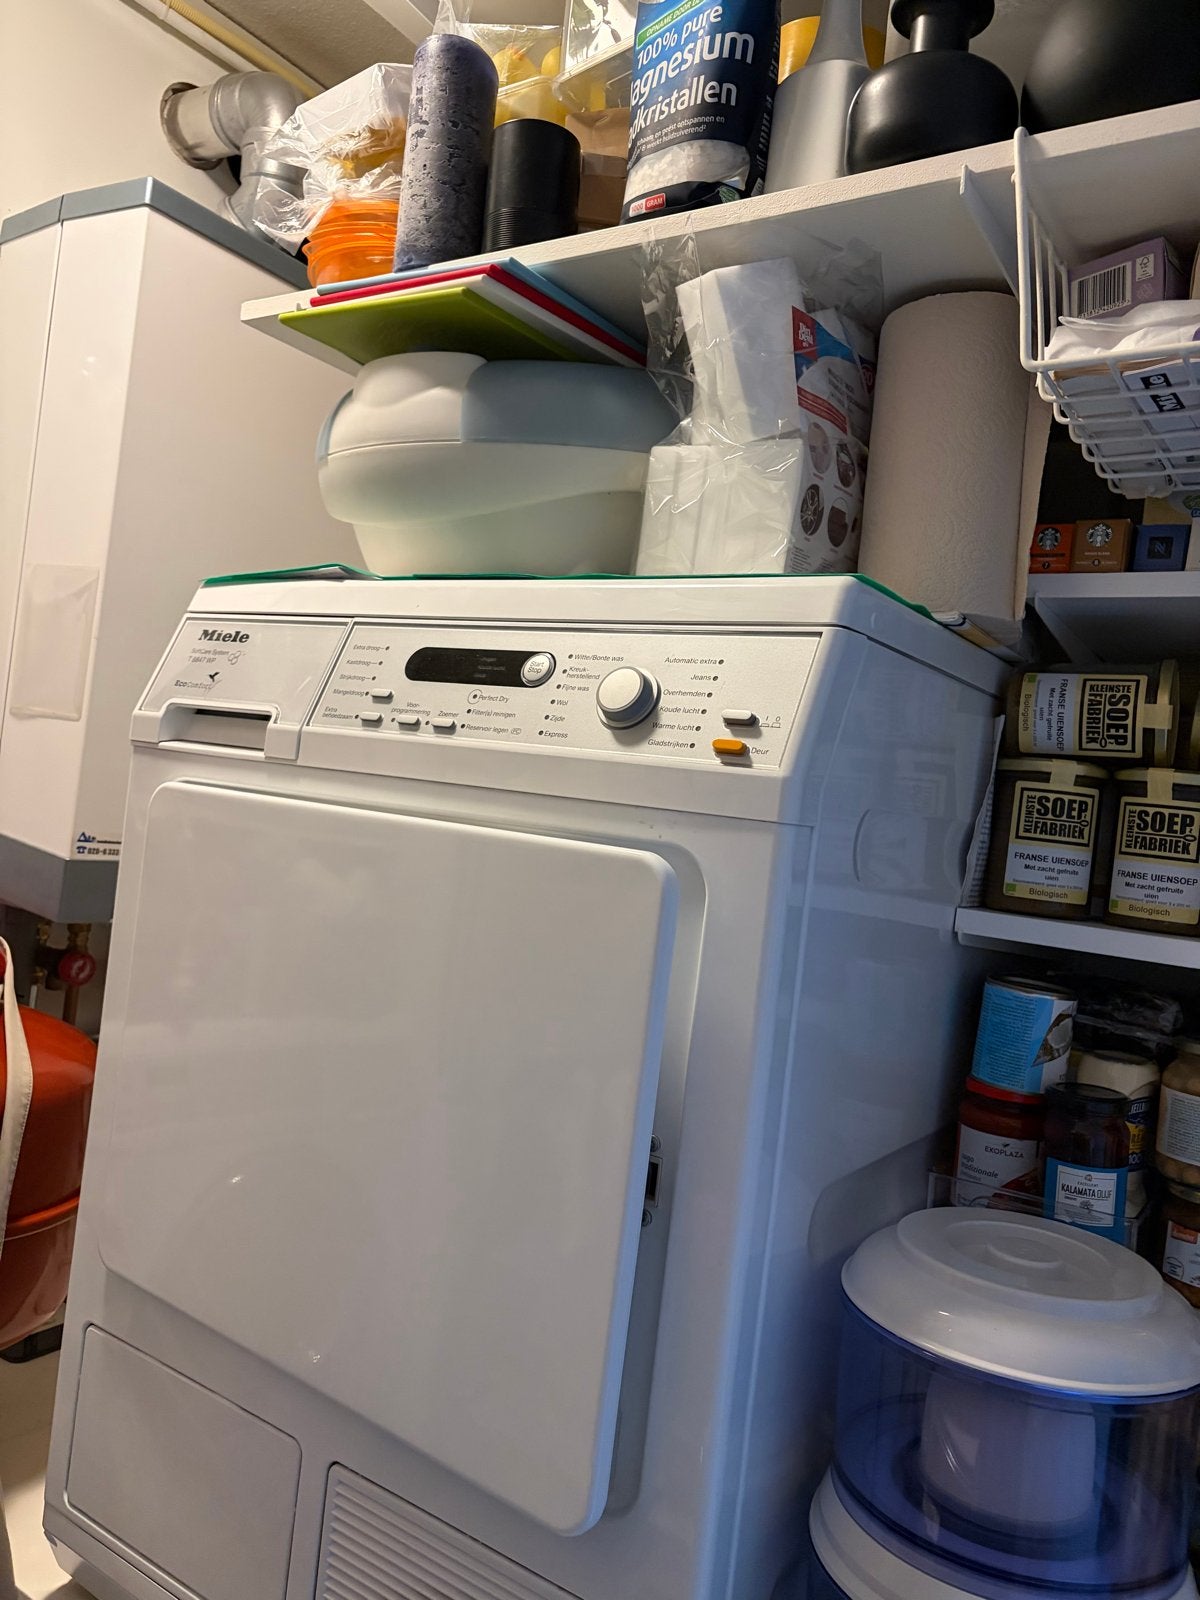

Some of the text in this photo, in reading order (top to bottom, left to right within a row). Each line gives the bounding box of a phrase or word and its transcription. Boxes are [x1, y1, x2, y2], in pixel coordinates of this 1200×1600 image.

[638, 5, 722, 69] 100% pure
[647, 197, 663, 208] GRAM
[198, 629, 250, 643] Miele
[346, 659, 371, 667] Kastdroog
[529, 660, 544, 668] Start
[527, 666, 542, 674] Stop
[340, 673, 366, 681] Strijkdroog
[333, 688, 365, 697] Mangeldroog
[562, 684, 577, 692] Fijne
[1089, 684, 1132, 694] KLEINSTE
[478, 694, 499, 702] Perfect
[663, 689, 706, 698] Overhemden
[391, 708, 431, 717] programmering
[438, 710, 459, 718] Zoemer
[472, 708, 516, 719] Filter(s) reinigen
[660, 705, 701, 714] Koude lucht
[1021, 694, 1032, 732] Biologisch
[1056, 678, 1069, 751] FRANSE UIENSOEP
[549, 715, 566, 723] Zijde
[1086, 693, 1103, 745] FABRIEK
[1106, 694, 1131, 746] SOEP
[466, 724, 493, 732] Reservoir
[651, 722, 695, 732] Warme lucht
[544, 731, 569, 739] Express
[647, 739, 689, 749] Gladstrijken
[750, 747, 769, 755] Deur
[1036, 795, 1089, 820] SOEP
[1022, 794, 1036, 833] KLEINSTE
[1136, 809, 1196, 835] SOEP
[1033, 820, 1085, 840] FABRIEK
[1124, 808, 1137, 849] KLEINSTE
[1133, 835, 1191, 856] FABRIEK
[1014, 851, 1089, 868] FRANSE UIENSOEP
[1056, 868, 1079, 876] gefruite
[1117, 869, 1198, 887] FRANSE UIENSOEP
[1028, 887, 1068, 899] Biologisch
[1156, 886, 1184, 894] gefruite
[1128, 904, 1171, 917] Biologisch
[984, 1145, 1025, 1159] EKOPLAZA
[1061, 1183, 1096, 1198] KALAMATA
